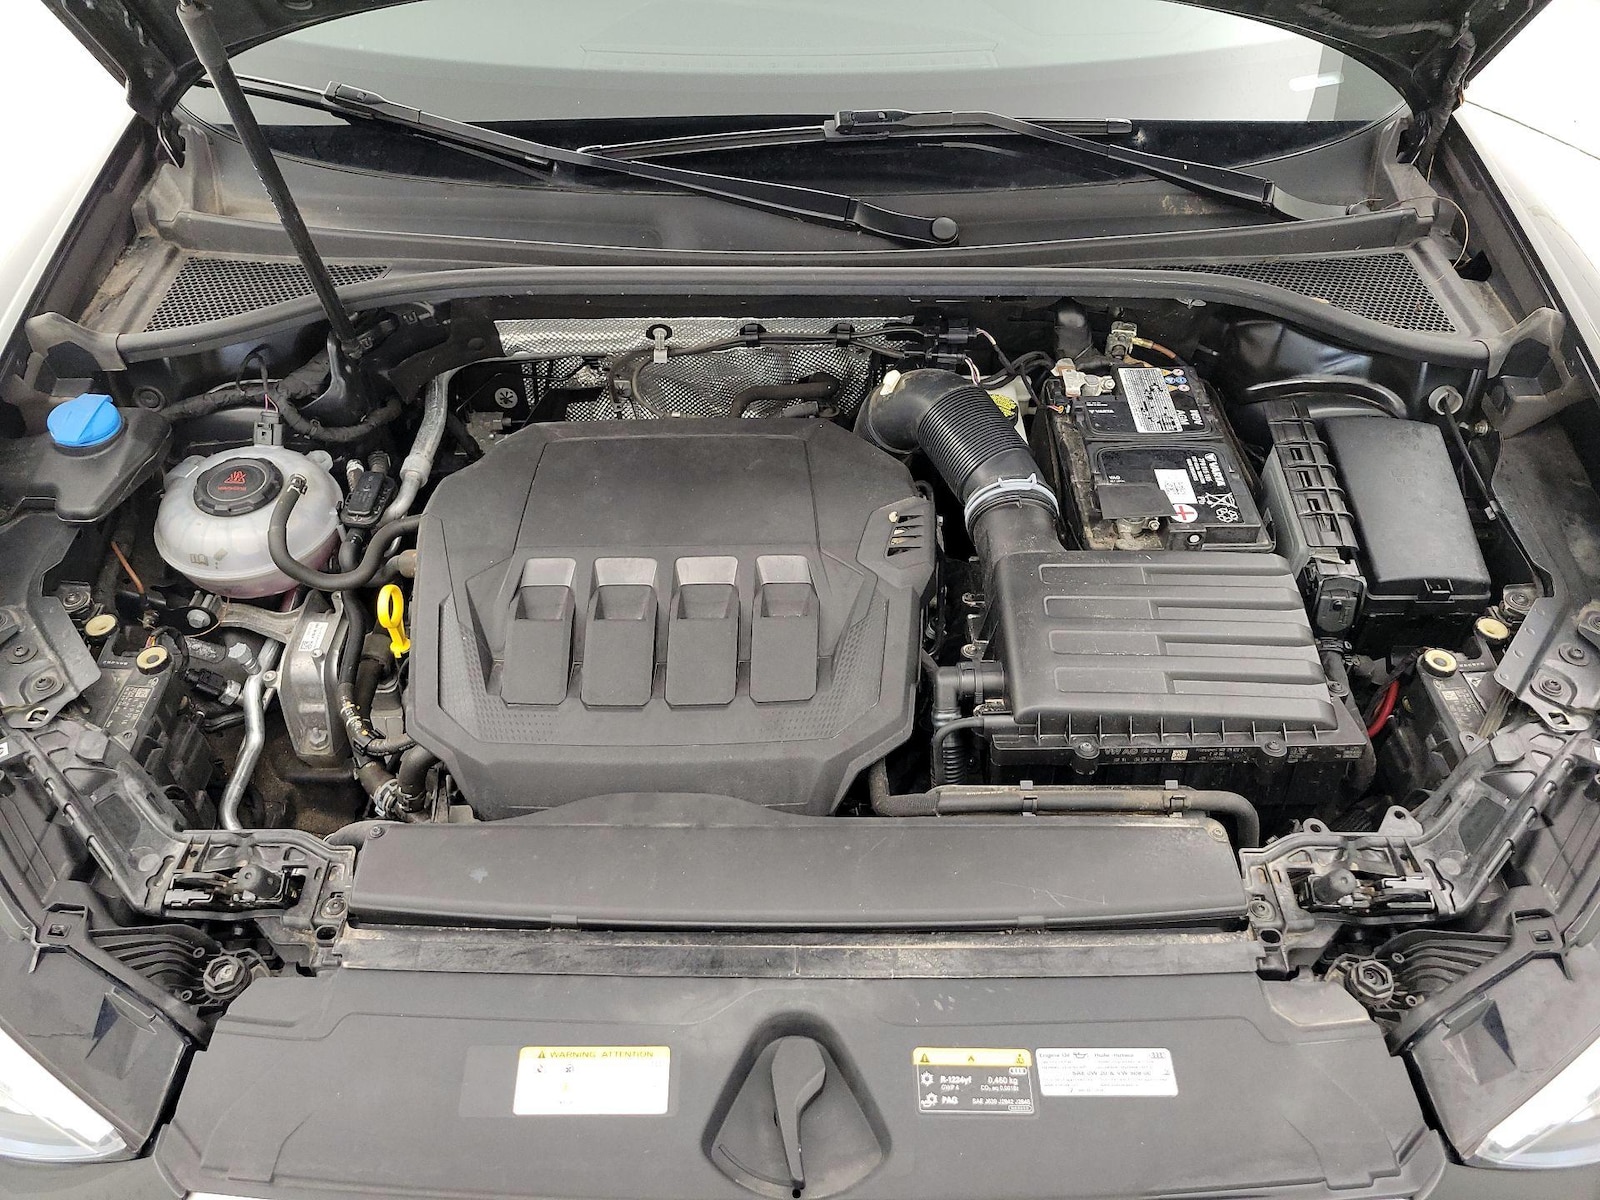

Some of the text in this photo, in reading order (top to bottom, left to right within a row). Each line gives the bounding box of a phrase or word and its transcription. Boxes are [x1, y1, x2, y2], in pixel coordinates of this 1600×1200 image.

[1209, 461, 1226, 487] VARTA
[1009, 1076, 1019, 1086] kg
[941, 1096, 959, 1105] PAG
